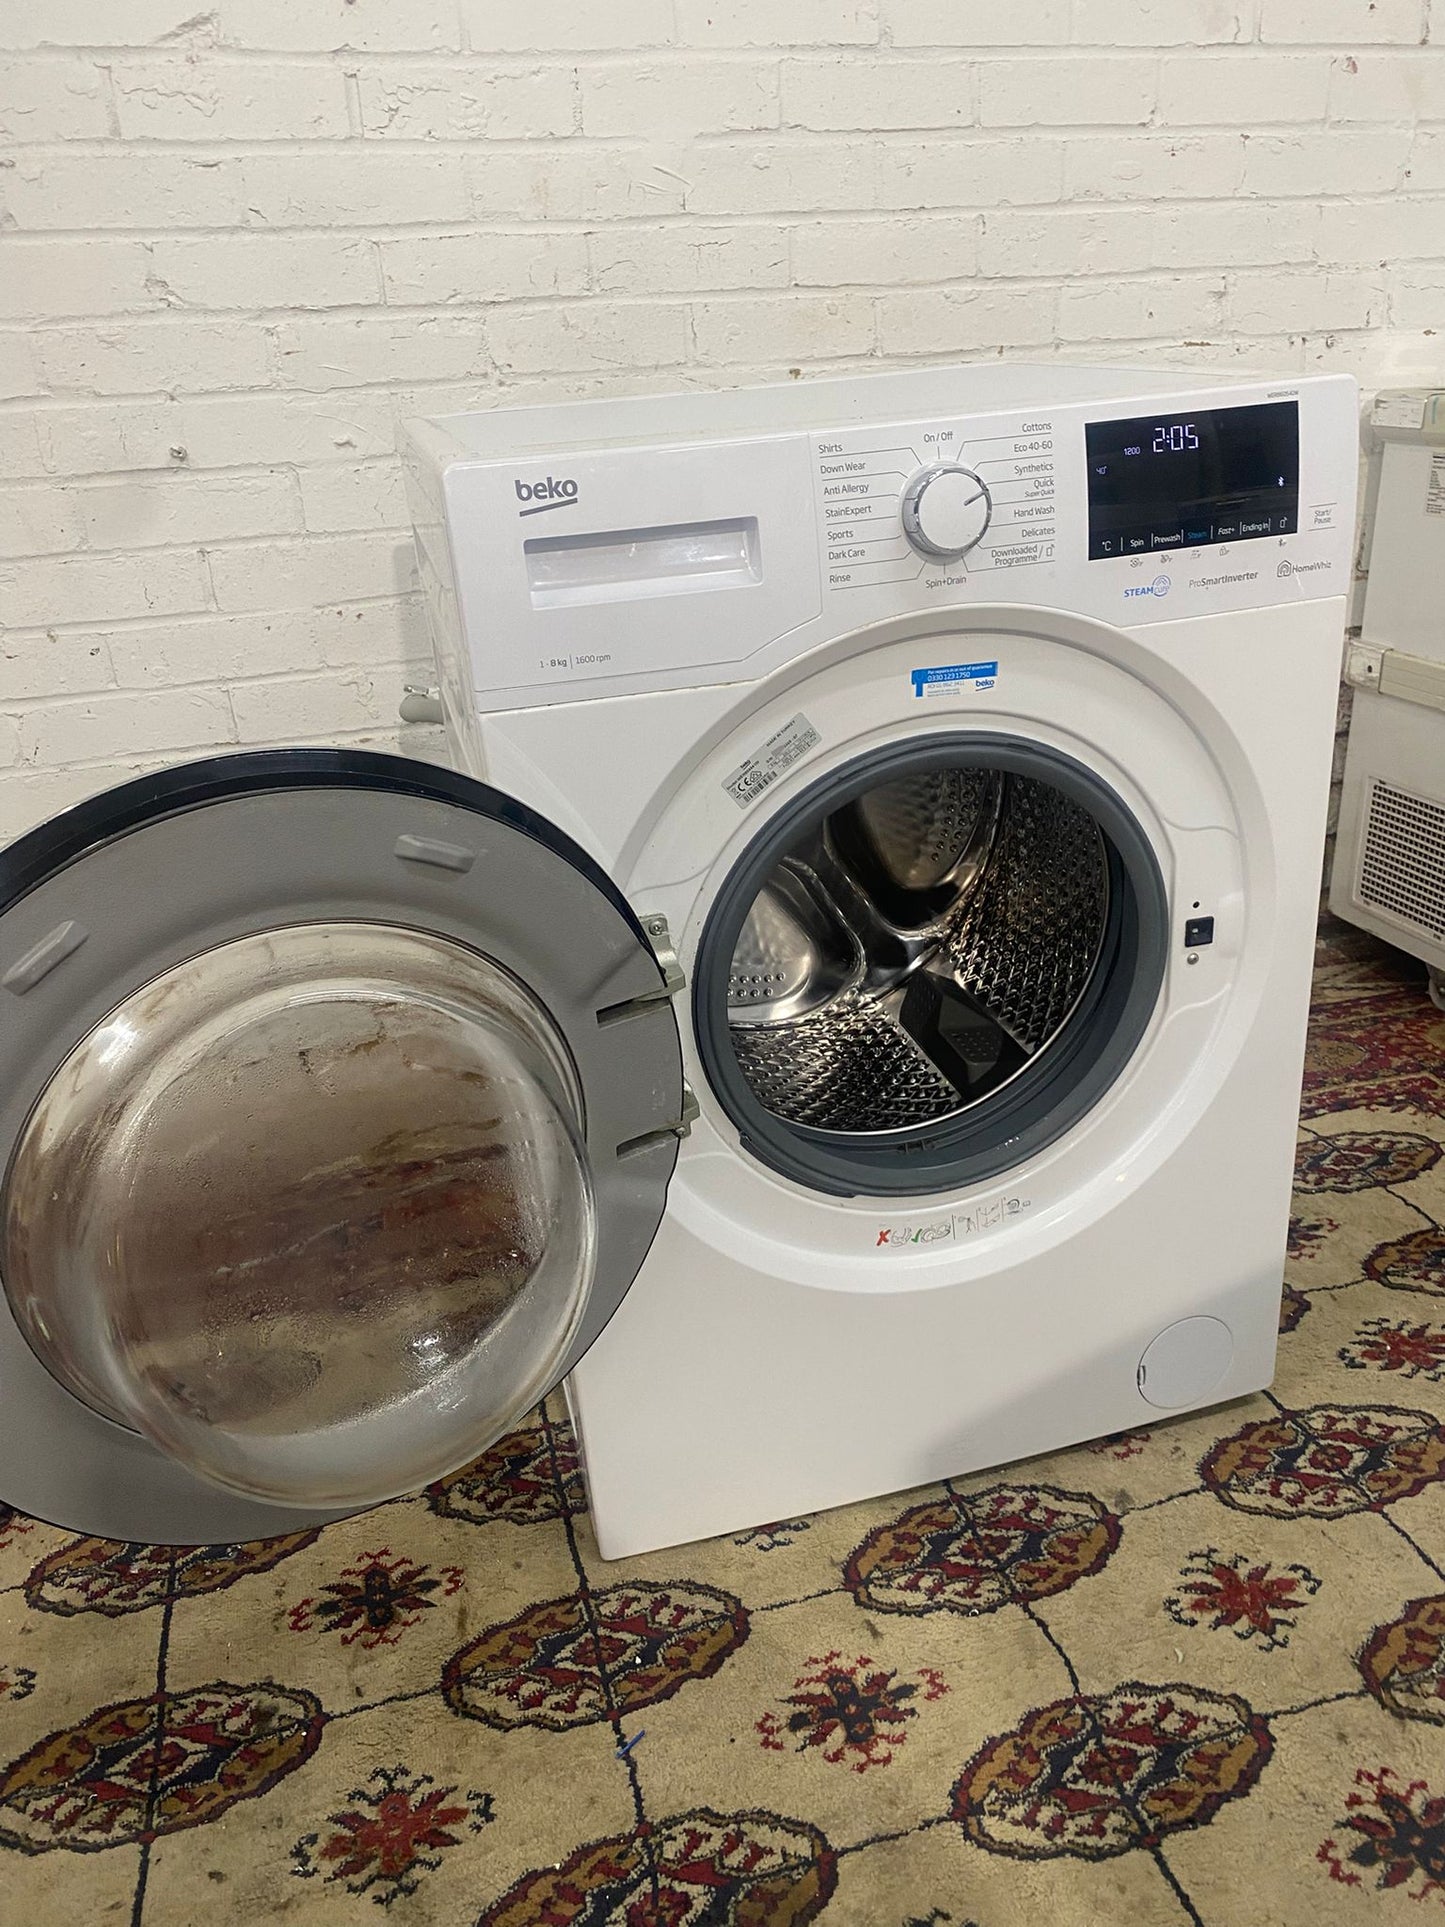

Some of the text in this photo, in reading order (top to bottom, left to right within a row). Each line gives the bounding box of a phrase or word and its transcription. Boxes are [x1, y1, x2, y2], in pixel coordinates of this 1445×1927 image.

[1022, 422, 1052, 434] Cottons
[923, 434, 936, 443] On
[940, 431, 954, 441] Off
[1152, 424, 1199, 453] 2:05
[818, 443, 843, 454] Shirts
[1014, 440, 1053, 453] Eco 40-60
[1124, 446, 1140, 456] 1200
[820, 461, 866, 474] Down Wear
[1014, 462, 1054, 476] Synthetics
[514, 476, 578, 502] beko
[823, 482, 870, 496] Anti Allergy
[1034, 478, 1054, 490] Quick
[1024, 488, 1054, 498] Super Quick
[825, 504, 872, 518] StainExpert
[1014, 506, 1055, 518] Hand Wash
[1021, 527, 1056, 538] Delicates
[1218, 526, 1236, 536] Fast+
[1242, 522, 1262, 533] Ending
[828, 529, 854, 542] Sports
[1154, 533, 1181, 544] Prewash
[1102, 541, 1112, 551] °C
[1130, 538, 1144, 548] Spin
[828, 548, 866, 560] Dark Care
[991, 546, 1038, 559] Downloaded
[994, 554, 1038, 566] Programme
[1292, 561, 1332, 574] HomeWhiz
[830, 573, 851, 584] Rinse
[925, 576, 967, 588] Spin+Drain
[1189, 571, 1259, 588] ProSmartInverter
[576, 655, 595, 664] 1600
[596, 654, 611, 663] rpm
